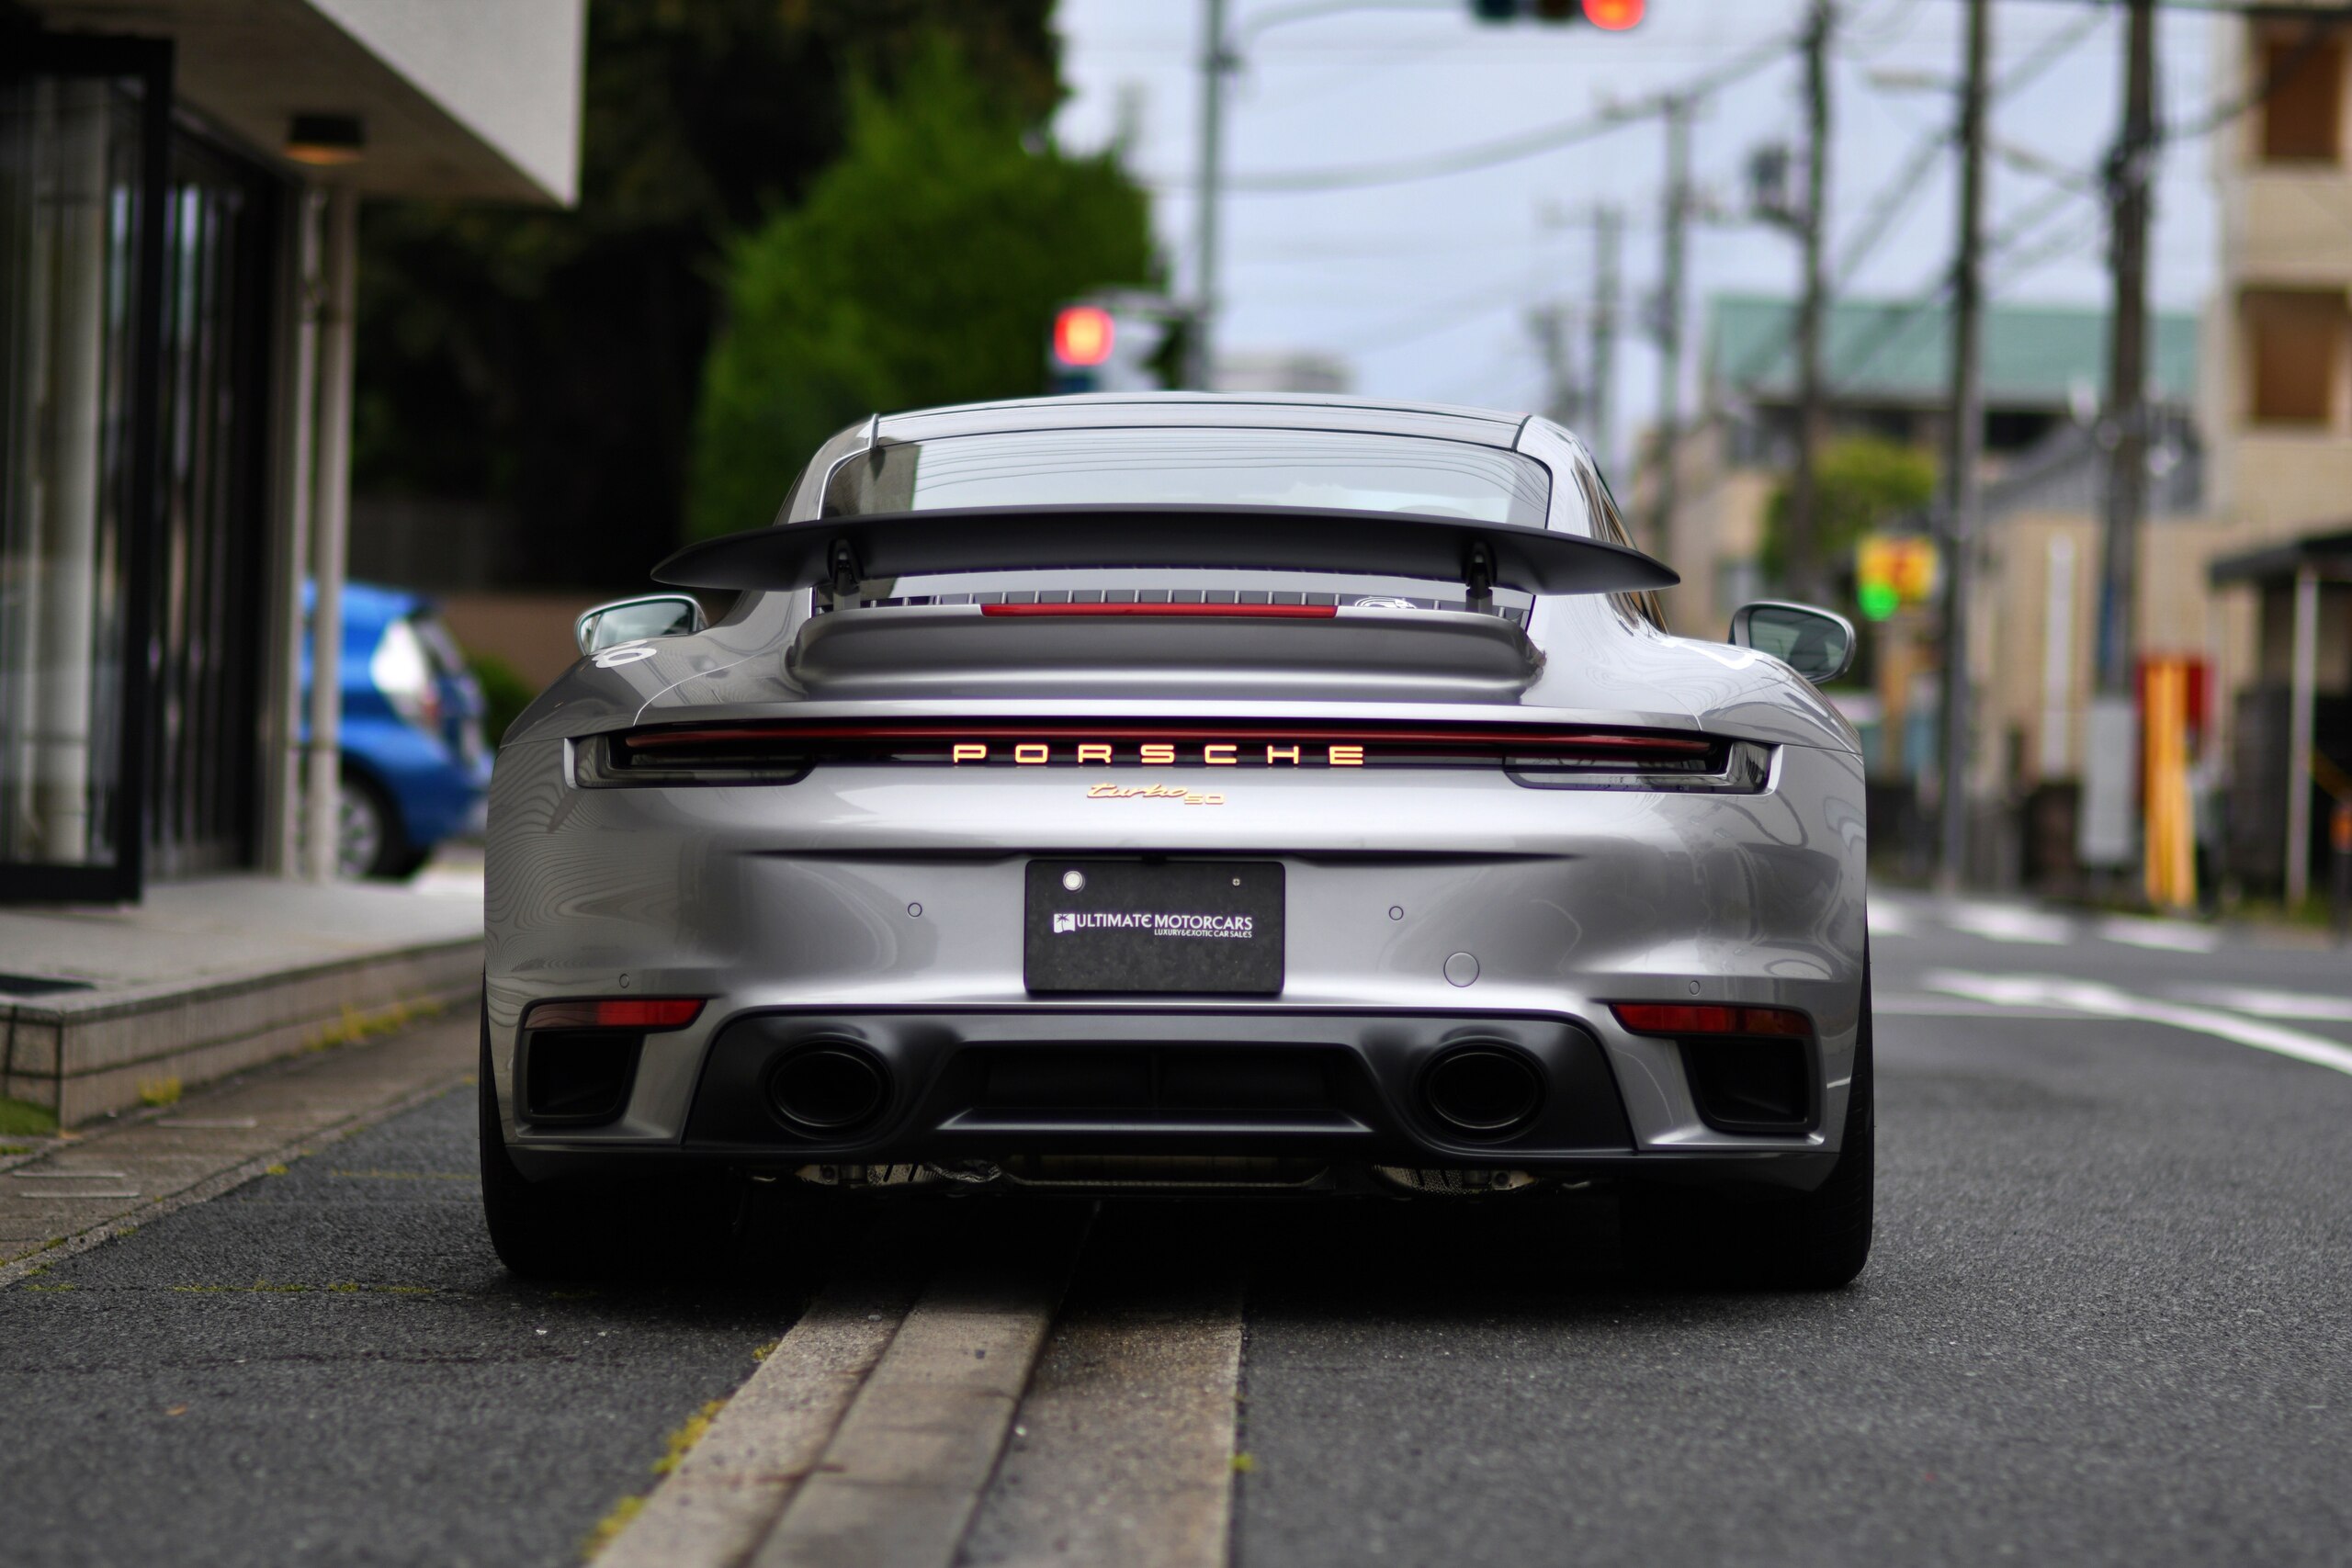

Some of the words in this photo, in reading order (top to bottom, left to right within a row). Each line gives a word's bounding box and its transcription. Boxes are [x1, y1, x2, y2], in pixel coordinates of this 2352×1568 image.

[954, 743, 1364, 765] PORSCHE
[1087, 783, 1188, 800] turbo
[1184, 793, 1225, 805] 50
[1076, 913, 1152, 928] ULTIMATE
[1154, 915, 1252, 930] MOTORCARS
[1229, 931, 1252, 939] SALES
